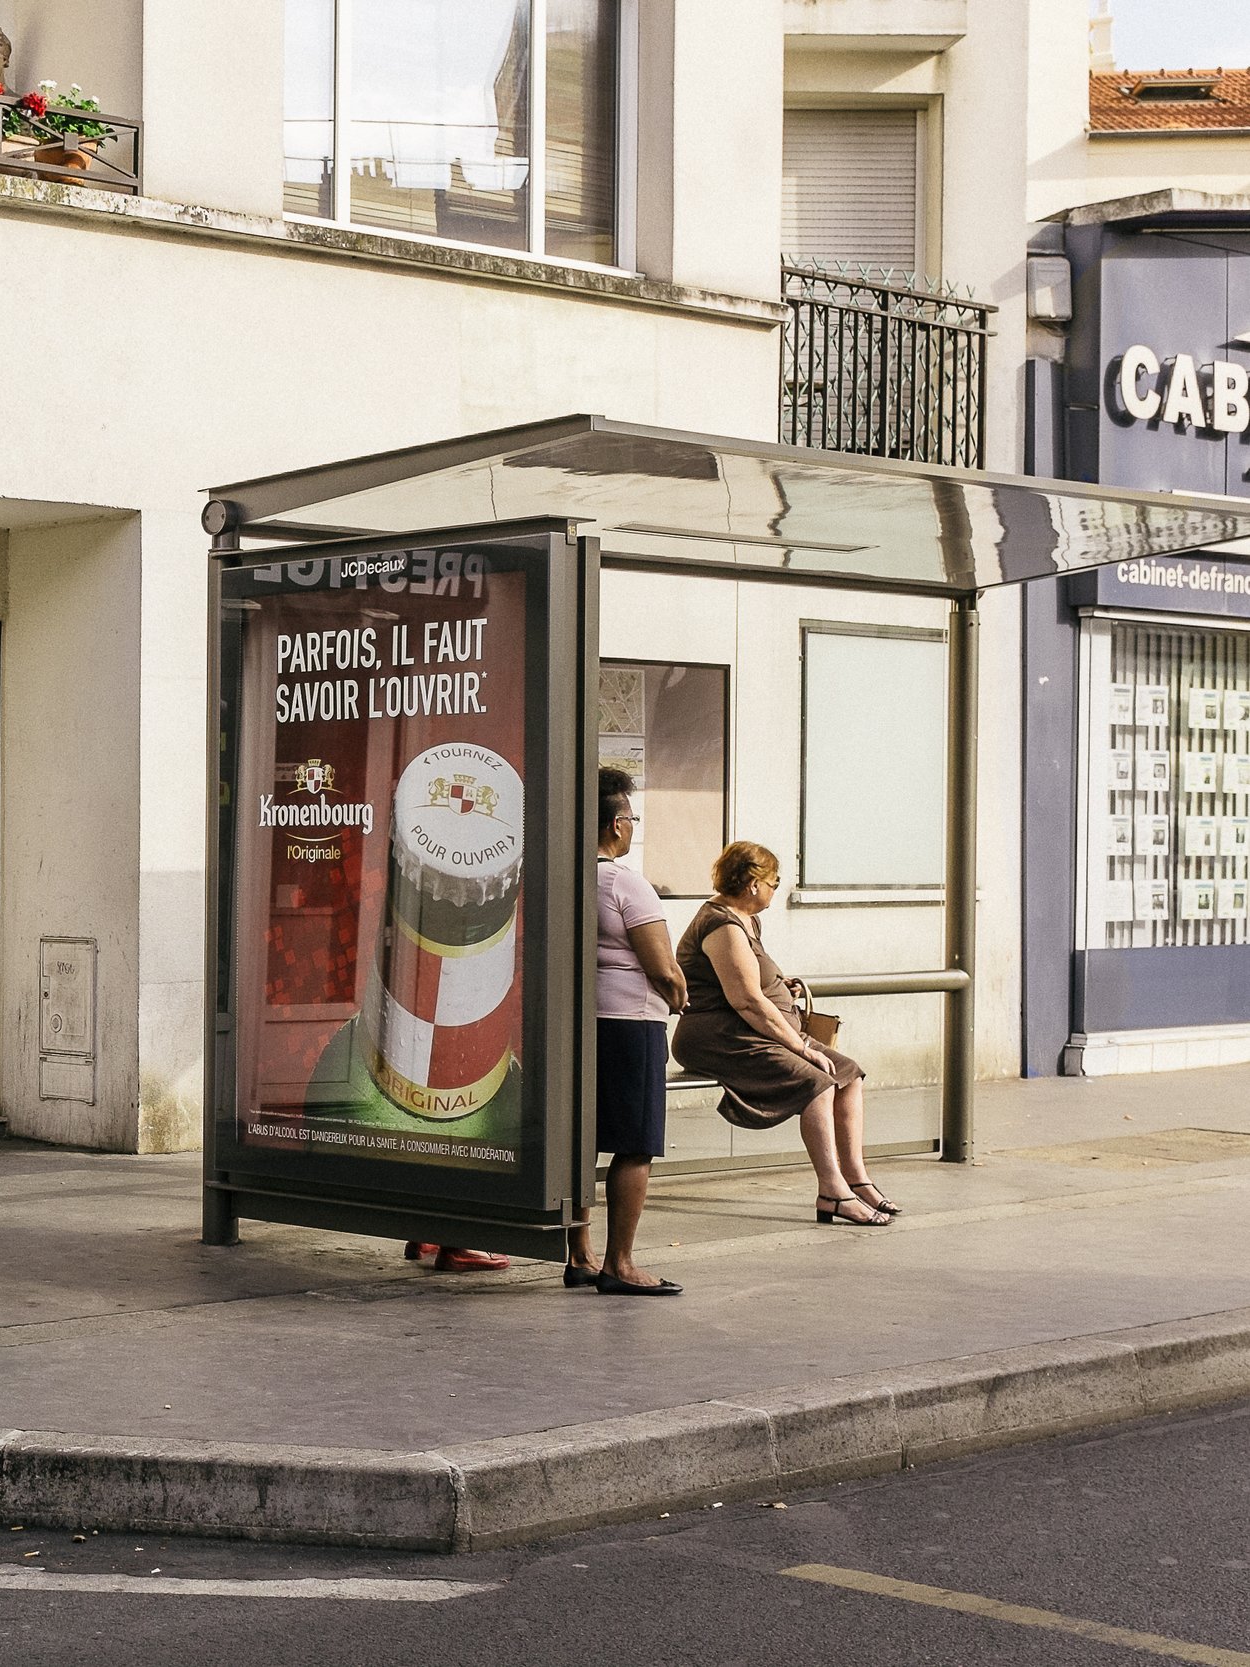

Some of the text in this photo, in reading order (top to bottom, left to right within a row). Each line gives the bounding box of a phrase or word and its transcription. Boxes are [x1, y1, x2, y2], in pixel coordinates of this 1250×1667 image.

[1120, 344, 1250, 433] CAB
[340, 558, 405, 579] JCDecaux
[277, 617, 488, 674] PARFOIS, IL FAUT
[276, 679, 359, 724] SAVOIR
[432, 747, 504, 771] TOURNEZ
[258, 793, 375, 836] Kronenbourg
[286, 844, 341, 864] l'Originale
[410, 824, 510, 866] POUR OUVRIR
[377, 1067, 479, 1112] ORIGINAL
[248, 1123, 268, 1136] L'ABUS
[269, 1125, 298, 1139] D'ALCOOL
[299, 1128, 310, 1140] EST
[311, 1130, 348, 1144] DANGEREUX
[348, 1134, 366, 1146] POUR
[367, 1136, 376, 1147] LA
[406, 1140, 451, 1155] CONSOMMER
[451, 1144, 469, 1157] AVEC
